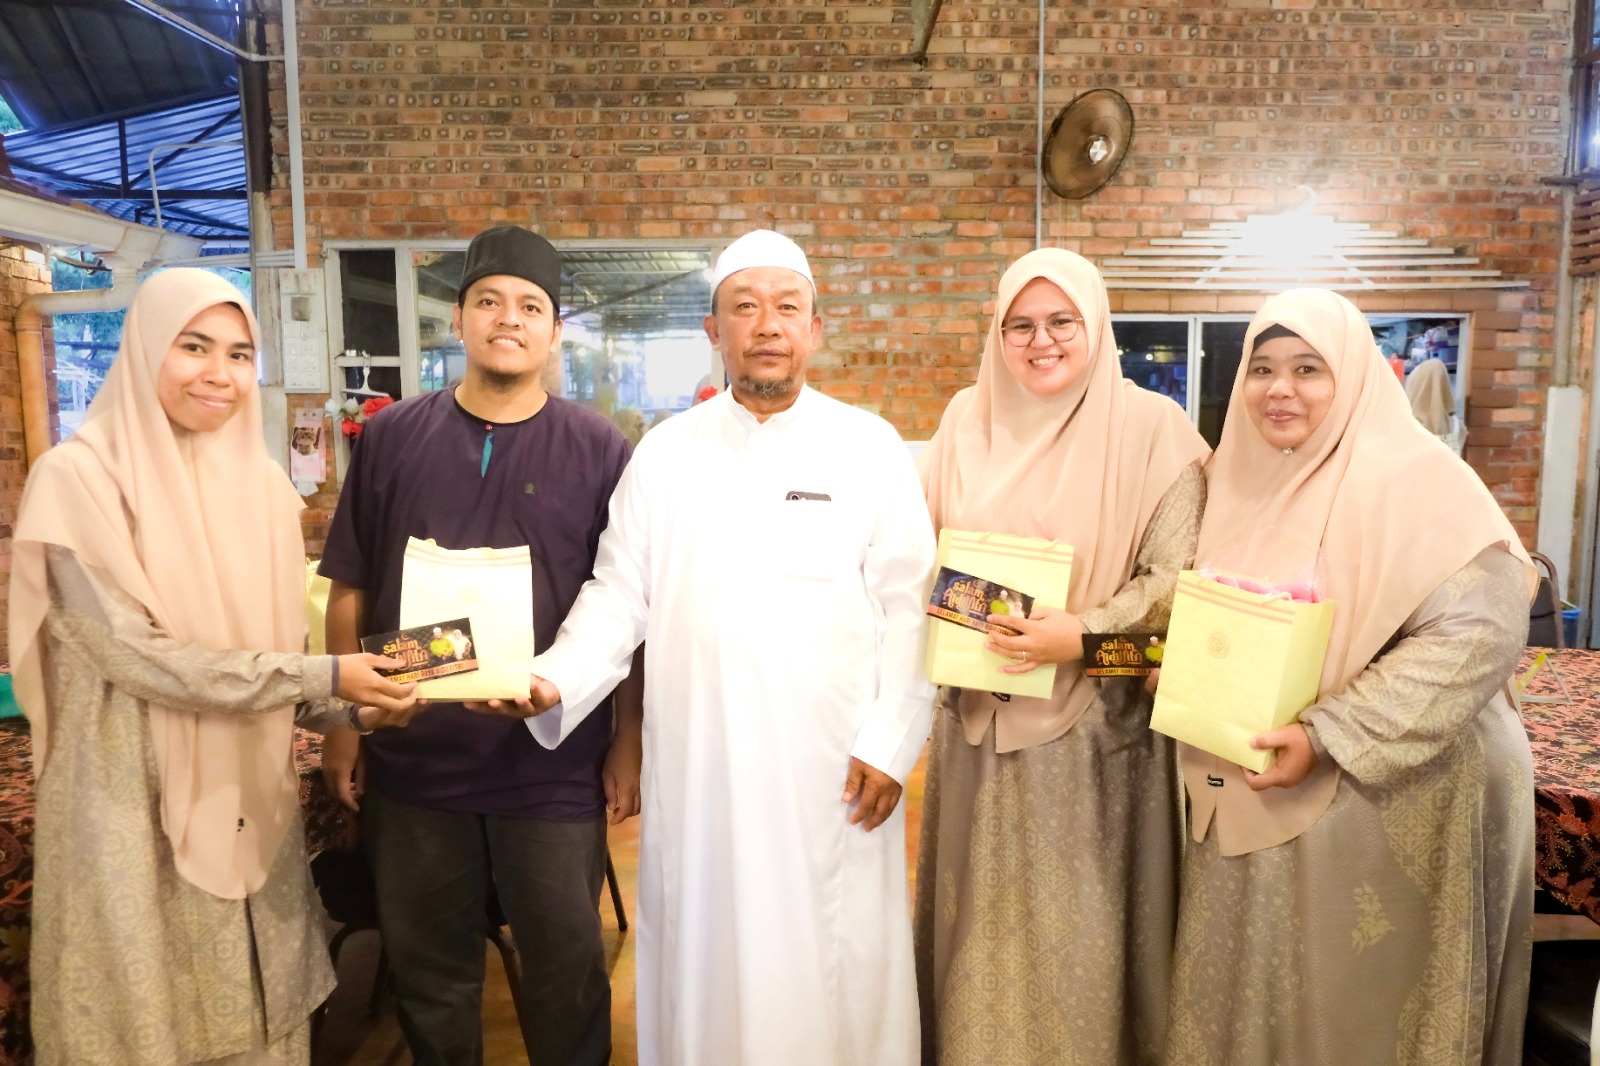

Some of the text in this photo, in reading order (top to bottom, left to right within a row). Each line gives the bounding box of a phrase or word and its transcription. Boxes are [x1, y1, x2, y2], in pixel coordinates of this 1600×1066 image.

[953, 581, 985, 599] salam
[383, 638, 419, 655] salam
[1101, 639, 1135, 650] salam
